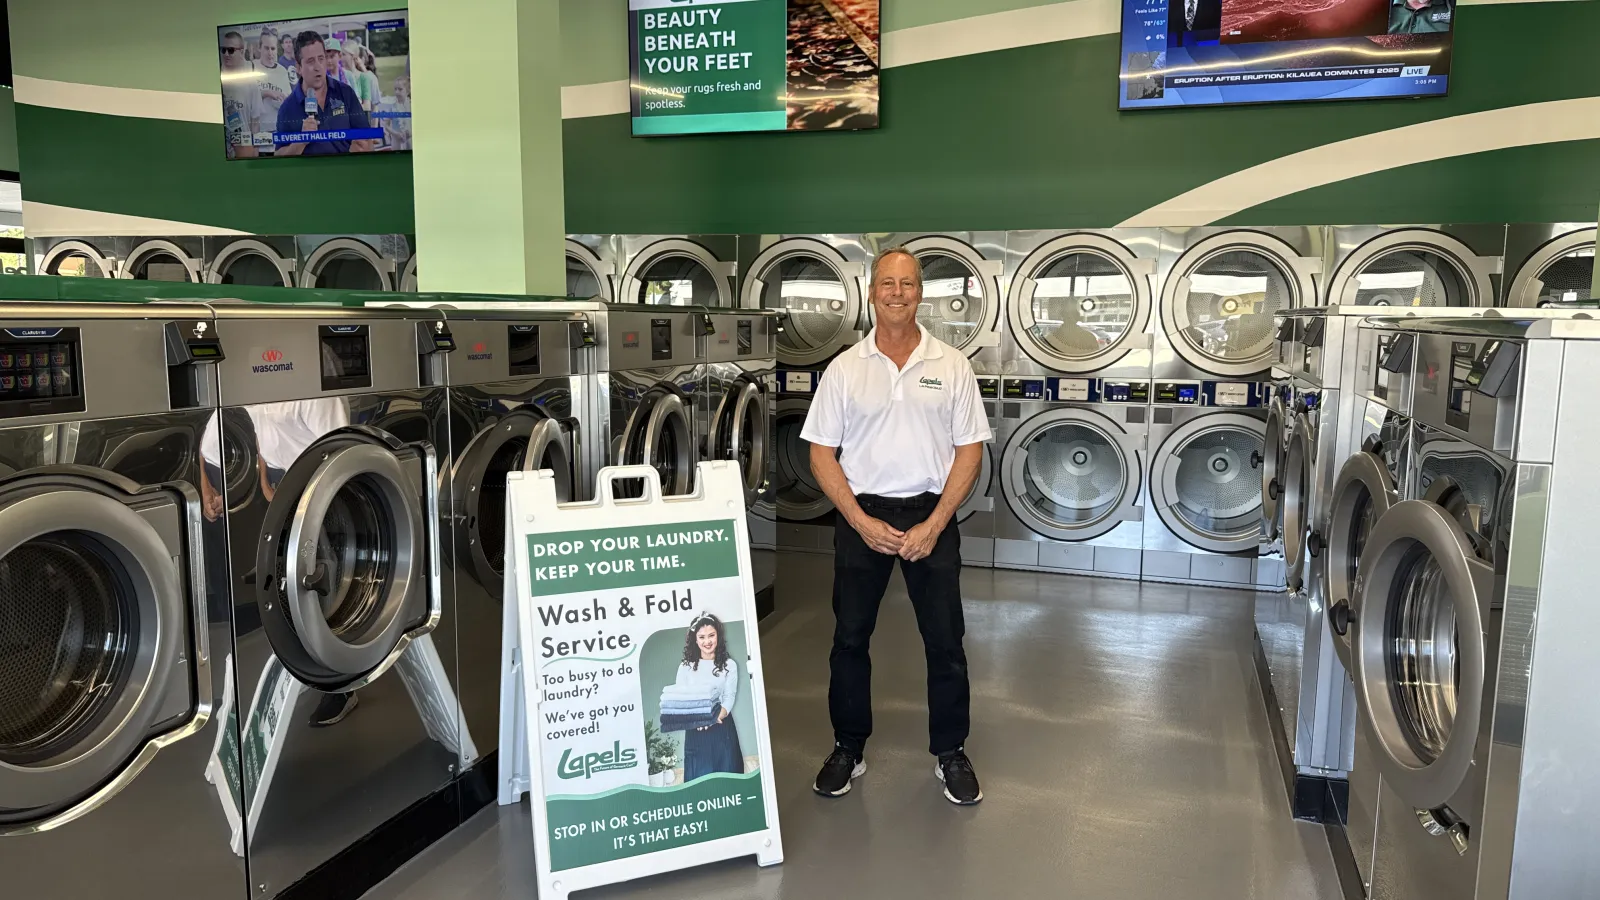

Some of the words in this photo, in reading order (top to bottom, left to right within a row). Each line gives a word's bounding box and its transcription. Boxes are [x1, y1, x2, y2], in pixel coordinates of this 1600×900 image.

[644, 8, 722, 29] BEAUTY
[645, 31, 736, 52] BENEATH
[645, 57, 699, 74] YOUR
[706, 52, 753, 71] FEET
[646, 86, 668, 96] Keep
[670, 85, 691, 94] your
[694, 85, 714, 94] rugs
[717, 81, 741, 92] fresh
[744, 80, 761, 90] and
[646, 99, 685, 111] spotless.
[252, 362, 293, 374] wascomat
[534, 540, 584, 558] DROP
[590, 536, 640, 552] YOUR
[646, 528, 729, 548] LAUNDRY.
[535, 564, 578, 581] KEEP
[585, 559, 635, 576] YOUR
[641, 555, 686, 572] TIME.
[538, 598, 606, 626] Wash
[618, 597, 636, 618] &
[646, 588, 693, 614] Fold
[541, 630, 631, 658] Service
[542, 674, 564, 686] Too
[569, 670, 597, 683] busy
[602, 668, 613, 679] to
[617, 664, 633, 676] do
[544, 684, 599, 701] laundry?
[545, 709, 585, 724] We've
[588, 705, 609, 722] got
[612, 703, 635, 718] you
[546, 722, 600, 740] covered!
[557, 740, 637, 780] Lapels
[554, 823, 587, 840] STOP
[591, 819, 606, 834] IN
[610, 815, 629, 830] OR
[632, 803, 694, 826] SCHEDULE
[696, 793, 742, 813] ONLINE
[613, 834, 636, 850] IT'S
[639, 828, 669, 845] THAT
[674, 820, 709, 841] EASY!
